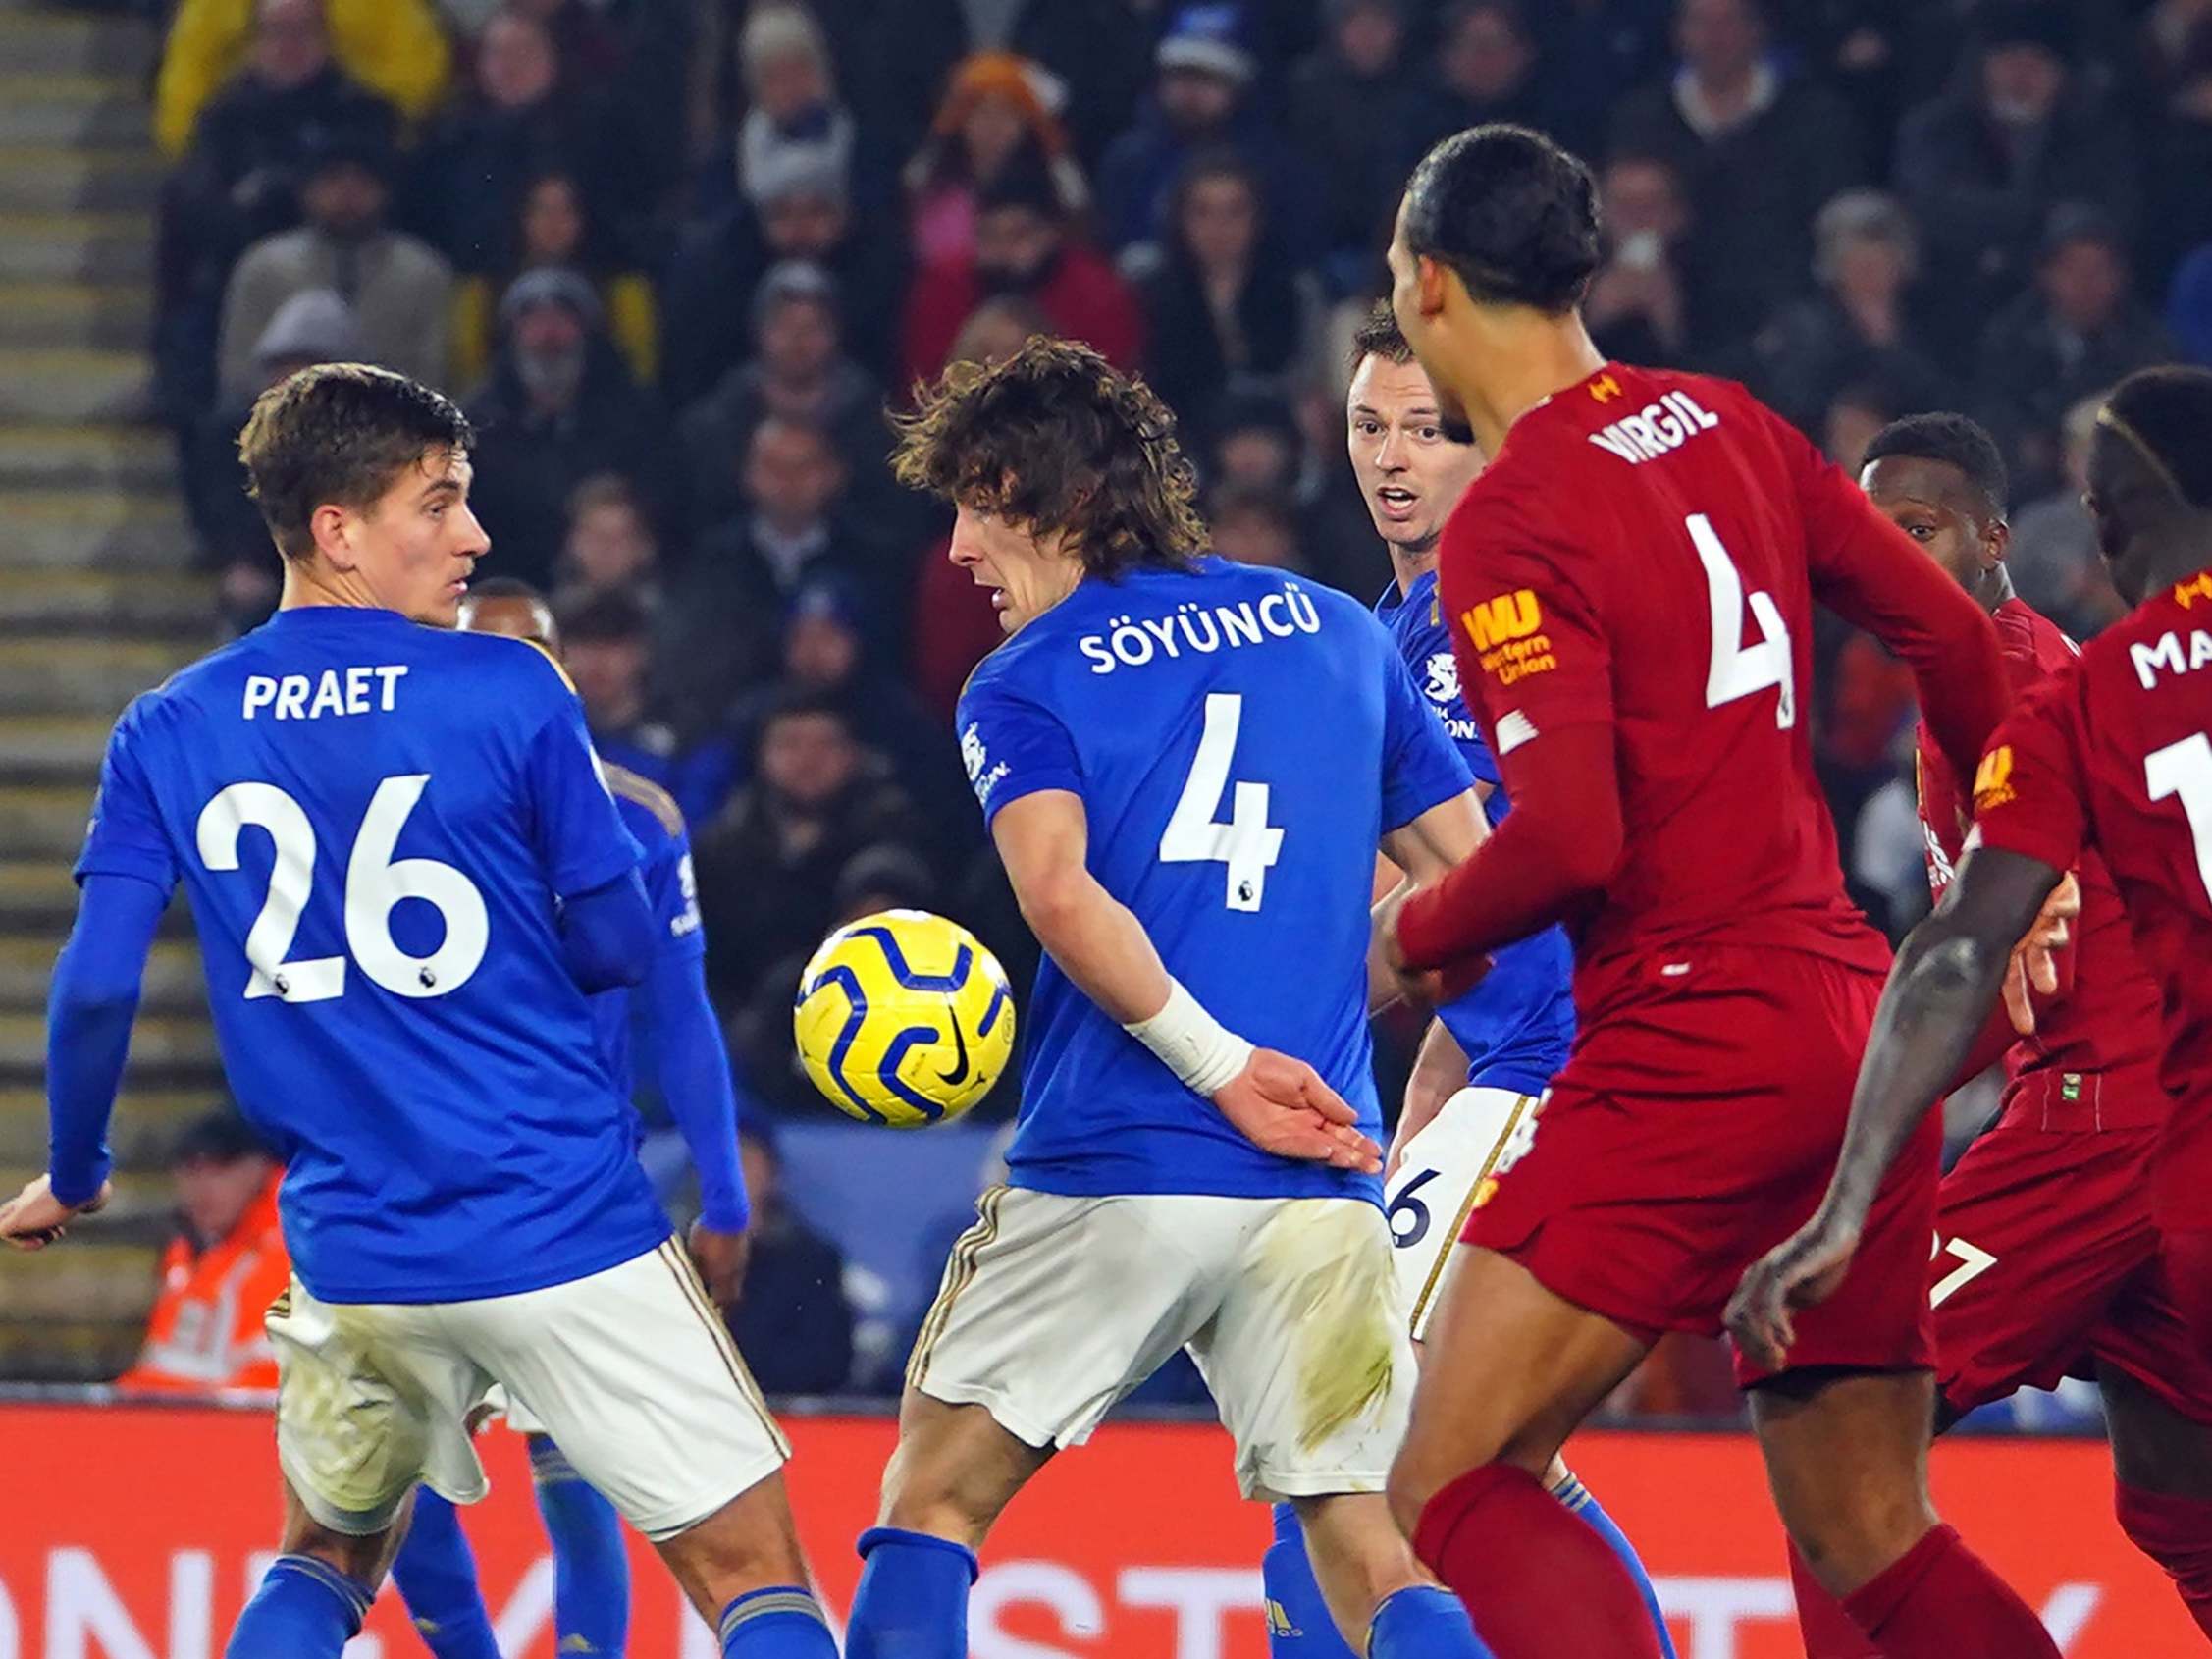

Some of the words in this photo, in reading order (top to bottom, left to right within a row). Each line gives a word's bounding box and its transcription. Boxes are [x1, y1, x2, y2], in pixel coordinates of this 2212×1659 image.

[1588, 390, 1718, 464] VIRGIL
[1080, 581, 1321, 674] SÖYÜNCÜ
[1461, 589, 1541, 652] WU
[1685, 512, 1795, 729] 4
[242, 665, 408, 720] PRAET
[1159, 693, 1285, 912] 4
[196, 774, 490, 1003] 26
[1389, 1168, 1442, 1249] 6
